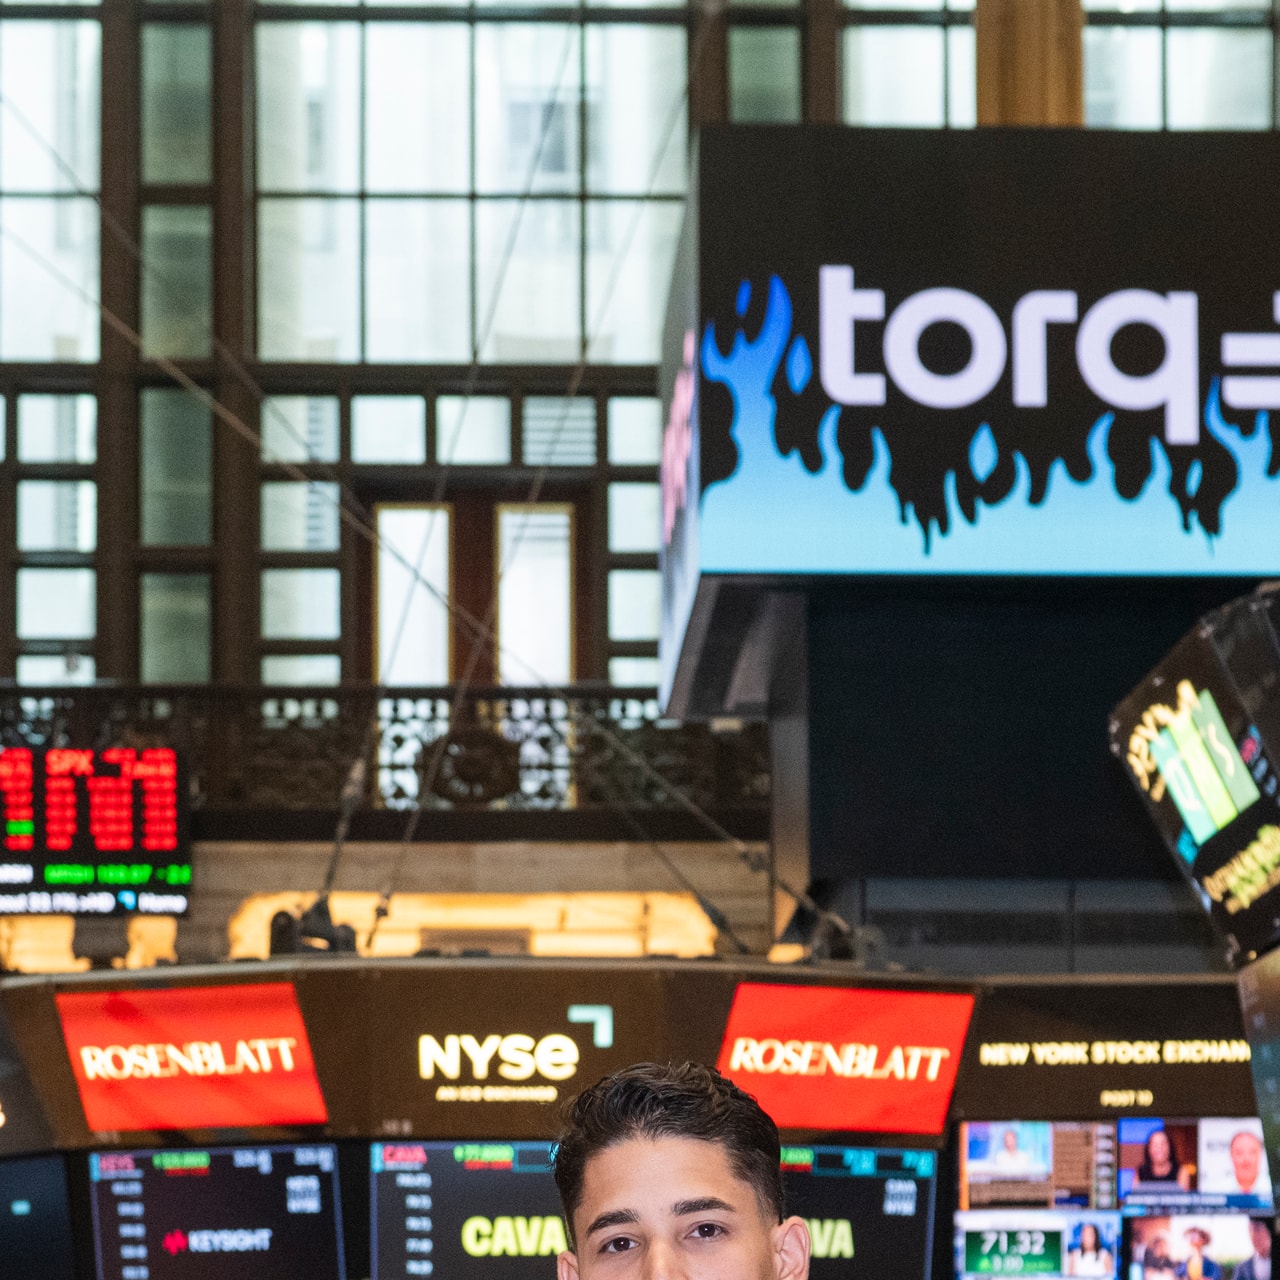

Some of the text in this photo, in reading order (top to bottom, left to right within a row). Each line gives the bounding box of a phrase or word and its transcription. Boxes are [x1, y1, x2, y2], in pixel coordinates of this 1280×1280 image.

[79, 1037, 296, 1080] ROSENBLATT
[728, 1037, 949, 1082] ROSENBLATT
[979, 1040, 1251, 1066] NEW YORK STOCK EXCHAN
[188, 1228, 272, 1252] KEYSIGHT
[805, 1219, 854, 1258] VA
